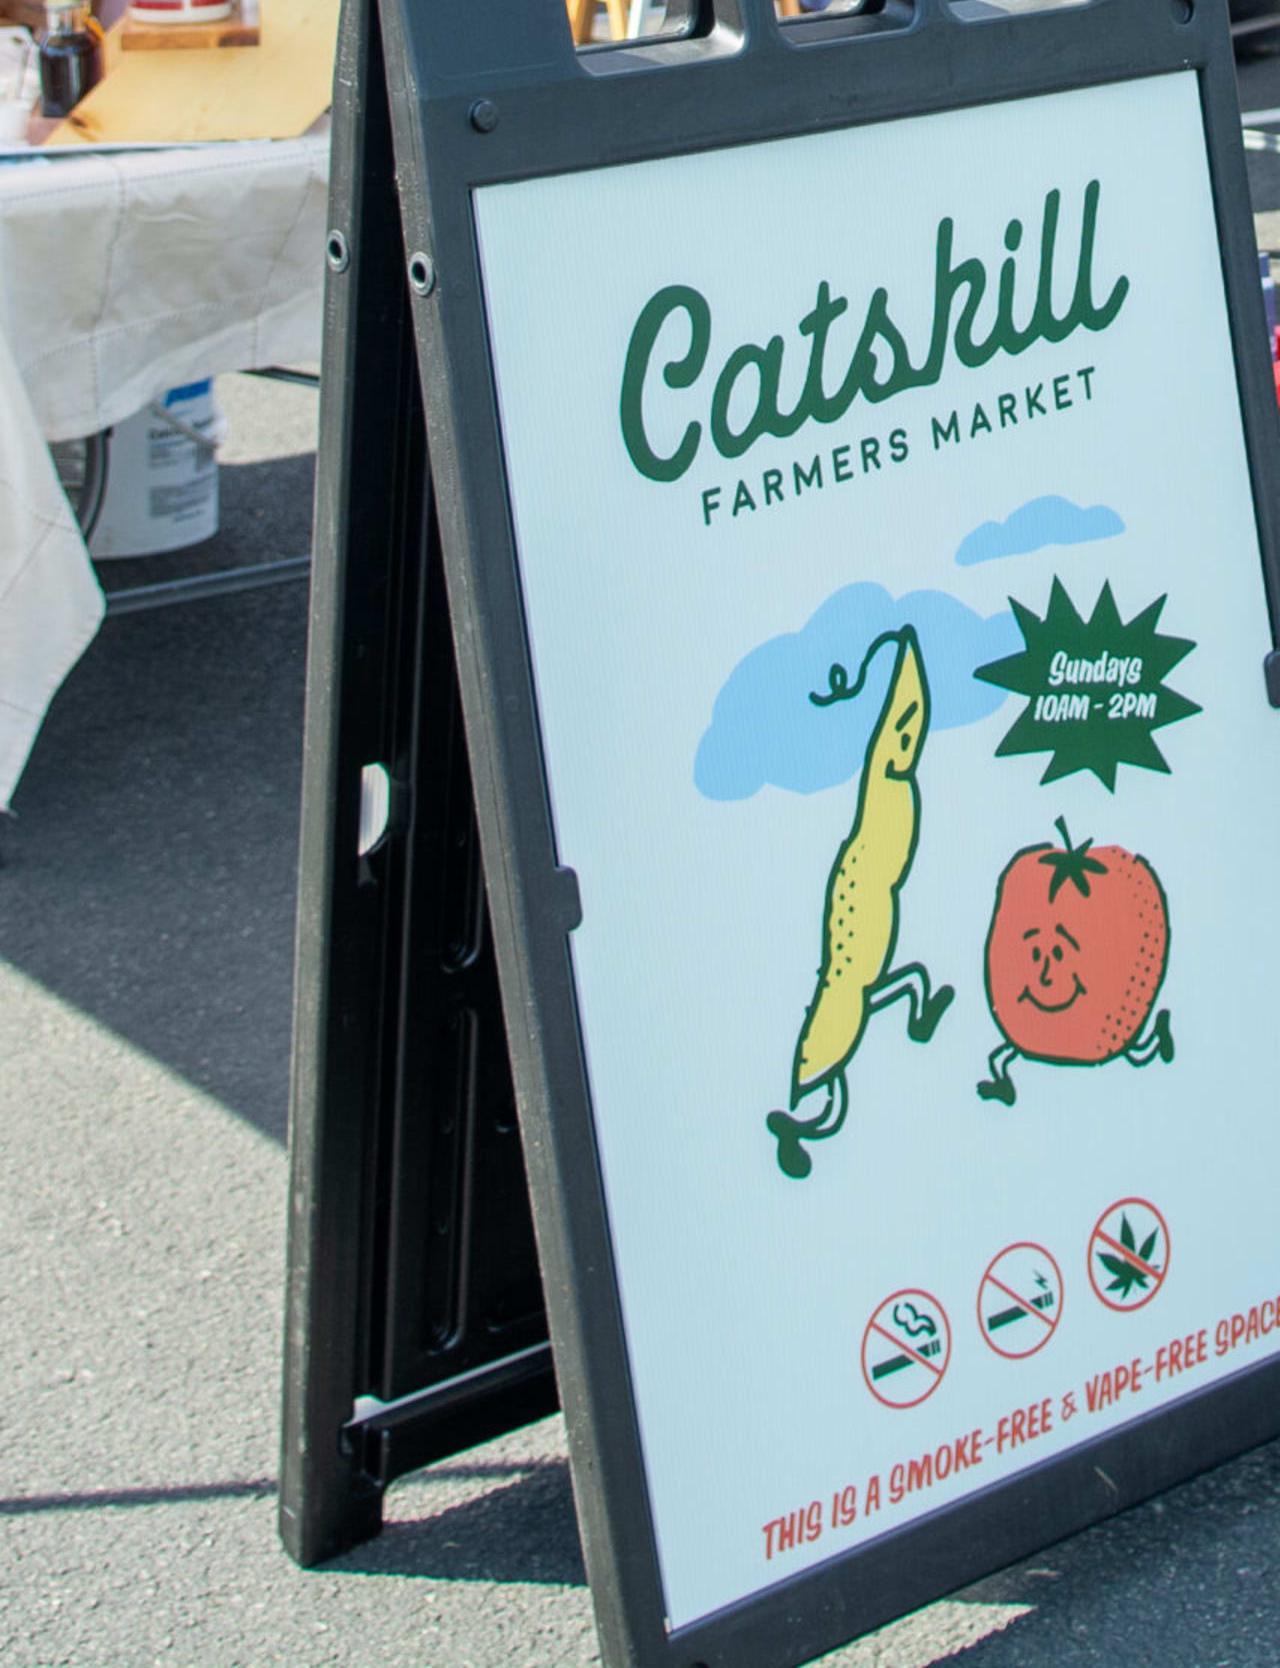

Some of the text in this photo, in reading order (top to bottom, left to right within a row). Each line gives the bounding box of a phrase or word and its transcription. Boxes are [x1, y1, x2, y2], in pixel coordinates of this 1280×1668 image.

[620, 179, 1129, 482] Catskill
[702, 366, 1094, 525] FARMERS MARKET
[1033, 693, 1090, 722] 10AM
[1107, 692, 1157, 719] 2PM
[1048, 650, 1142, 687] Sundays
[762, 1500, 822, 1560] THIS
[831, 1485, 857, 1528] IS
[865, 1475, 881, 1517] A
[889, 1398, 1053, 1505] SMOKE-FREE
[1061, 1392, 1077, 1422] &
[1085, 1329, 1207, 1413] VAPE-FREE
